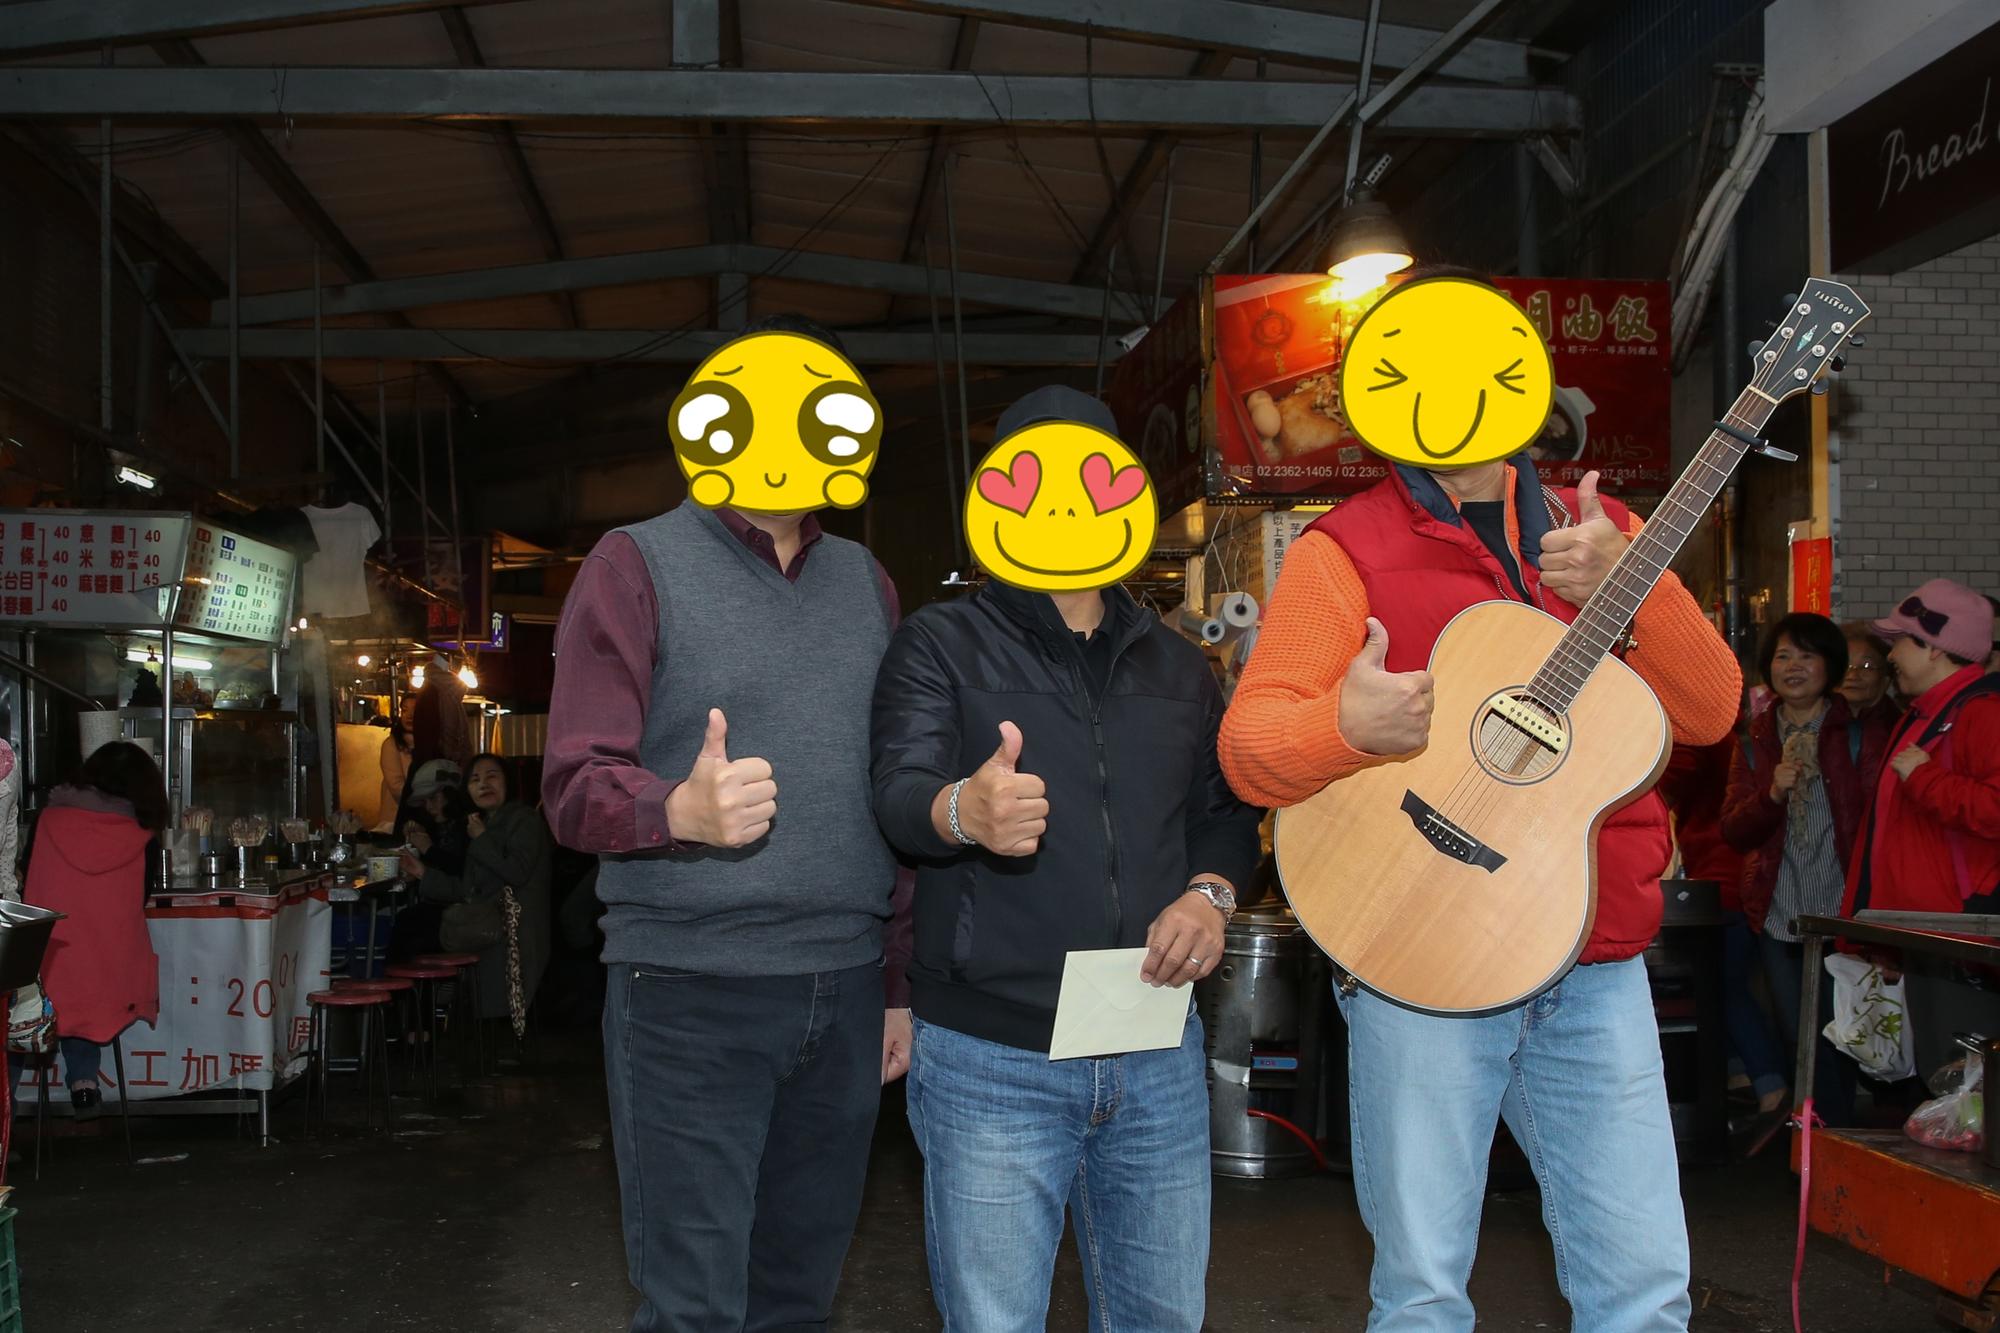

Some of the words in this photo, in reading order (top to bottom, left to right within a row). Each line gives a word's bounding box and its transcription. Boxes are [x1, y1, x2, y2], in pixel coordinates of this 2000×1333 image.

[1878, 76, 1991, 210] Bread
[1503, 289, 1657, 342] 月油飯
[1257, 466, 1271, 477] 02
[1274, 465, 1333, 478] 2362-1405
[1342, 466, 1355, 477] 02
[1359, 465, 1390, 478] 2363-
[1537, 468, 1552, 479] 55
[54, 526, 70, 539] 40
[145, 530, 161, 543] 40
[1273, 515, 1285, 579] 以上產品
[52, 550, 69, 564] 40
[144, 555, 160, 567] 40
[0, 570, 33, 590] 台目
[51, 575, 68, 588] 40
[143, 573, 160, 586] 45
[51, 599, 68, 612] 40
